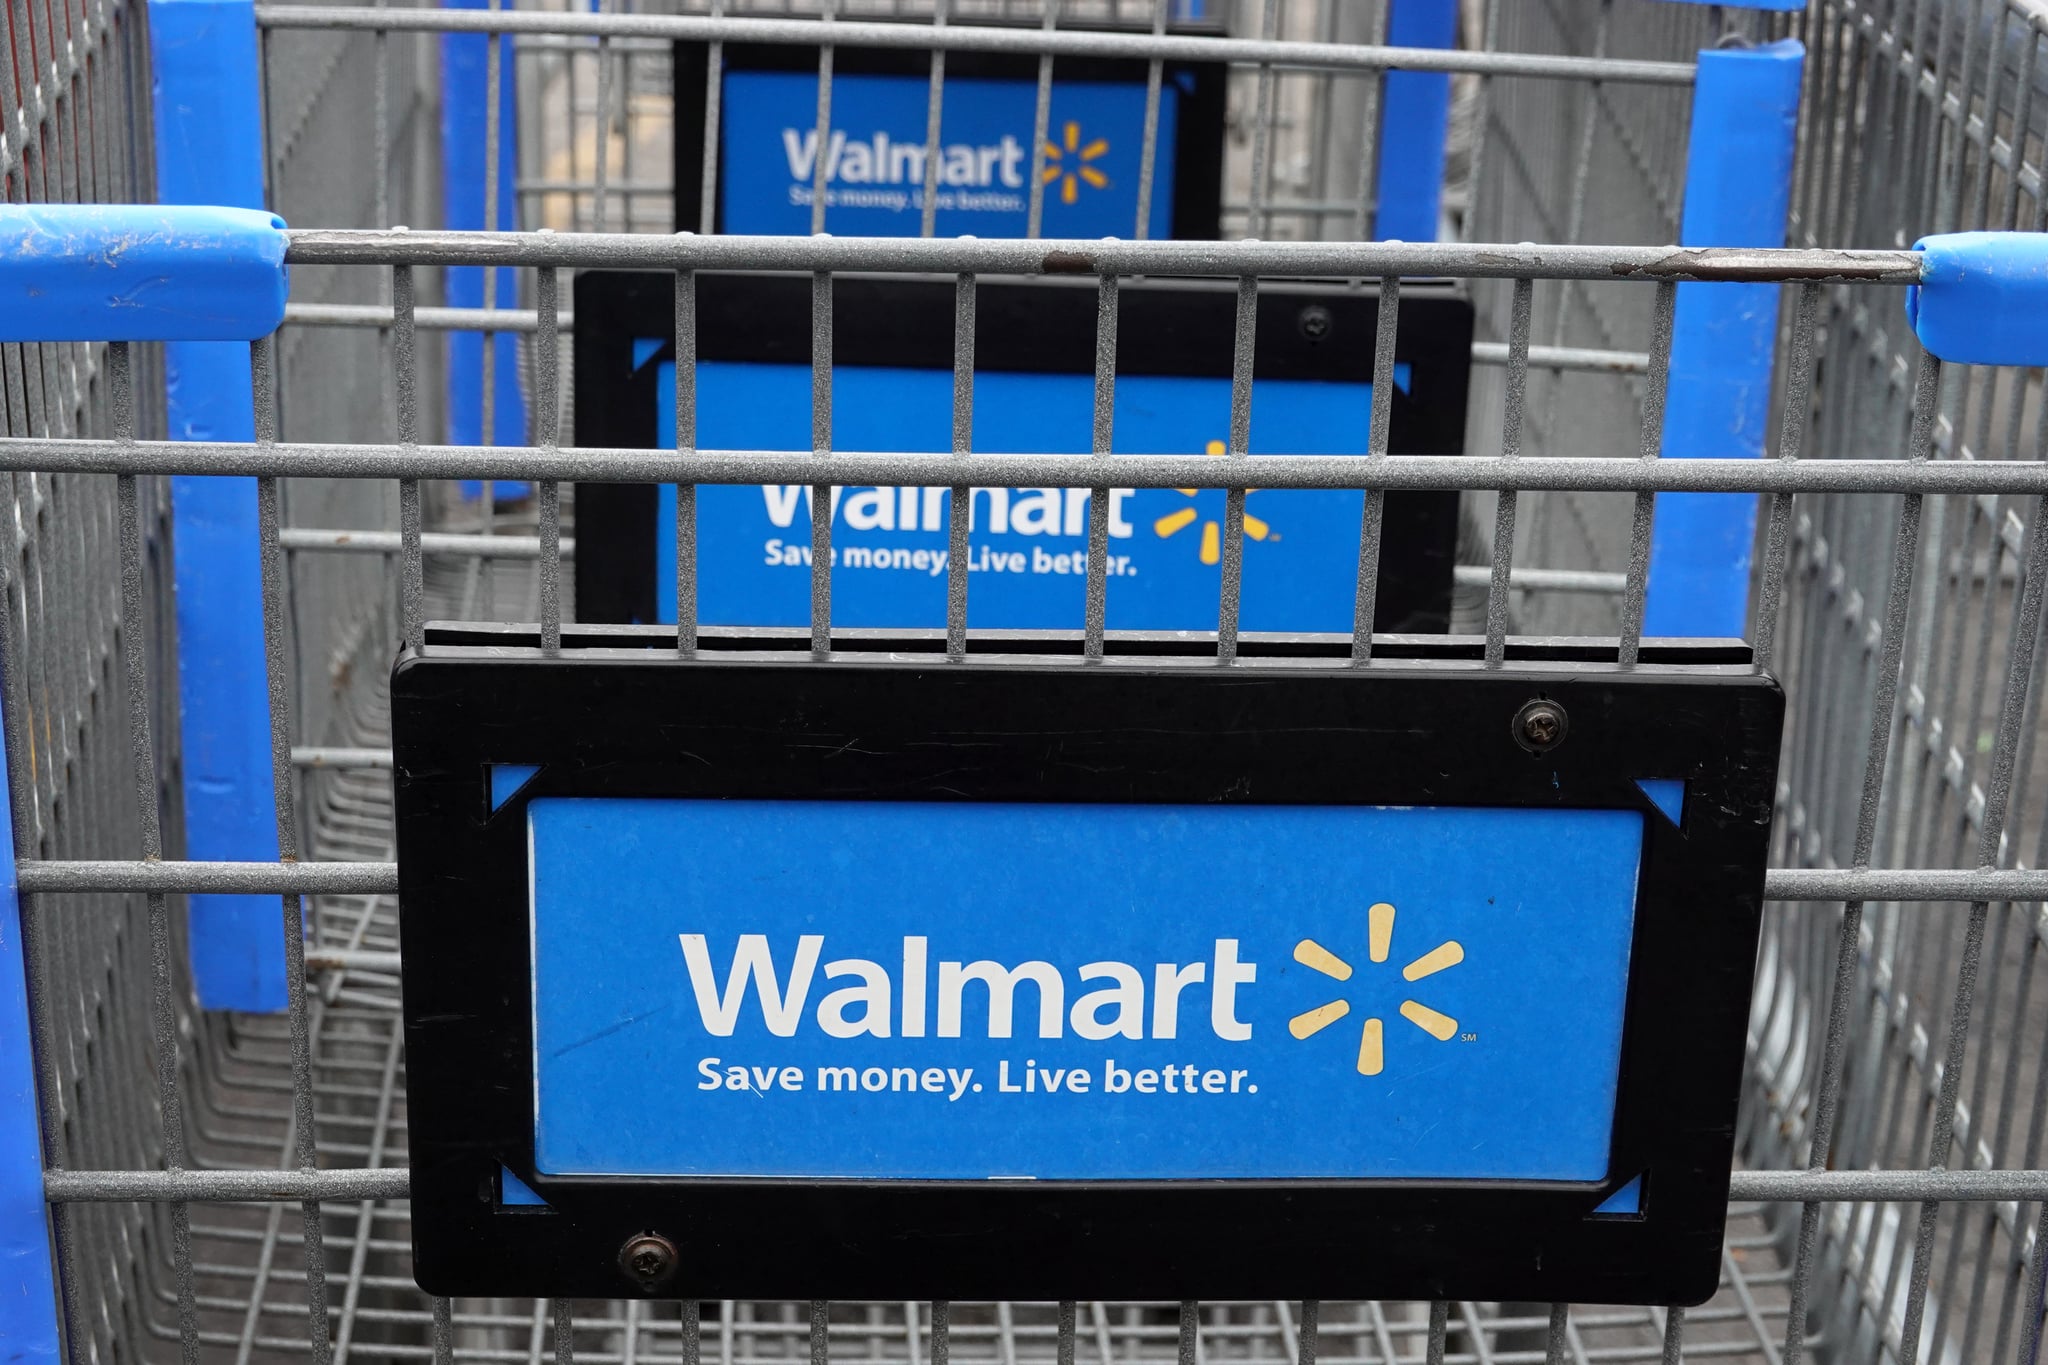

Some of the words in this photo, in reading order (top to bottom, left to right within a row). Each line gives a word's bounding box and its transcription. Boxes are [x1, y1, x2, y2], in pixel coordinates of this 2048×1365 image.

[782, 127, 1024, 188] Walmart
[789, 184, 837, 206] Sae
[912, 187, 955, 211] Lve
[967, 545, 1027, 573] Live
[1032, 546, 1138, 576] beter.
[679, 933, 1257, 1042] Walmart
[1461, 1033, 1477, 1042] SM
[697, 1057, 804, 1091] Save
[817, 1066, 983, 1102] money.
[998, 1059, 1091, 1093] Live
[1104, 1059, 1258, 1094] better.
